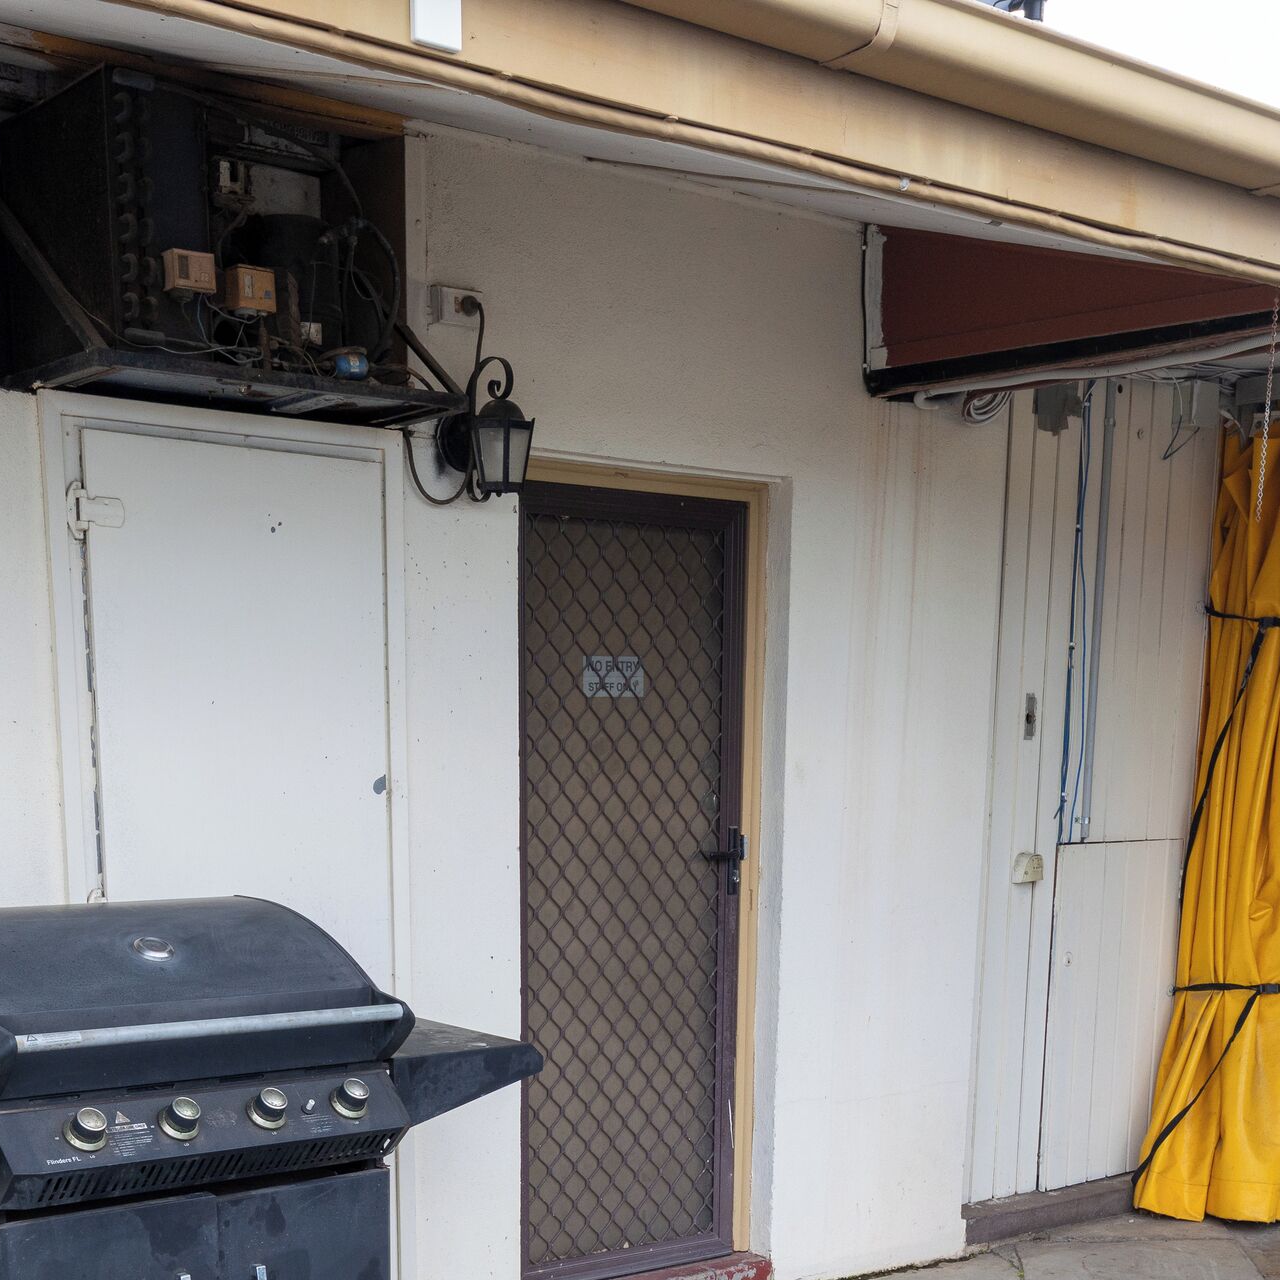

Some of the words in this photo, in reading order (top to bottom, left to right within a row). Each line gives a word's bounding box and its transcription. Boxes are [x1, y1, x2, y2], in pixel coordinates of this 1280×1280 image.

[587, 660, 602, 672] NO
[606, 660, 640, 673] ENTRY
[588, 682, 615, 692] STFF
[616, 681, 639, 692] OY
[46, 1157, 72, 1166] Flinders
